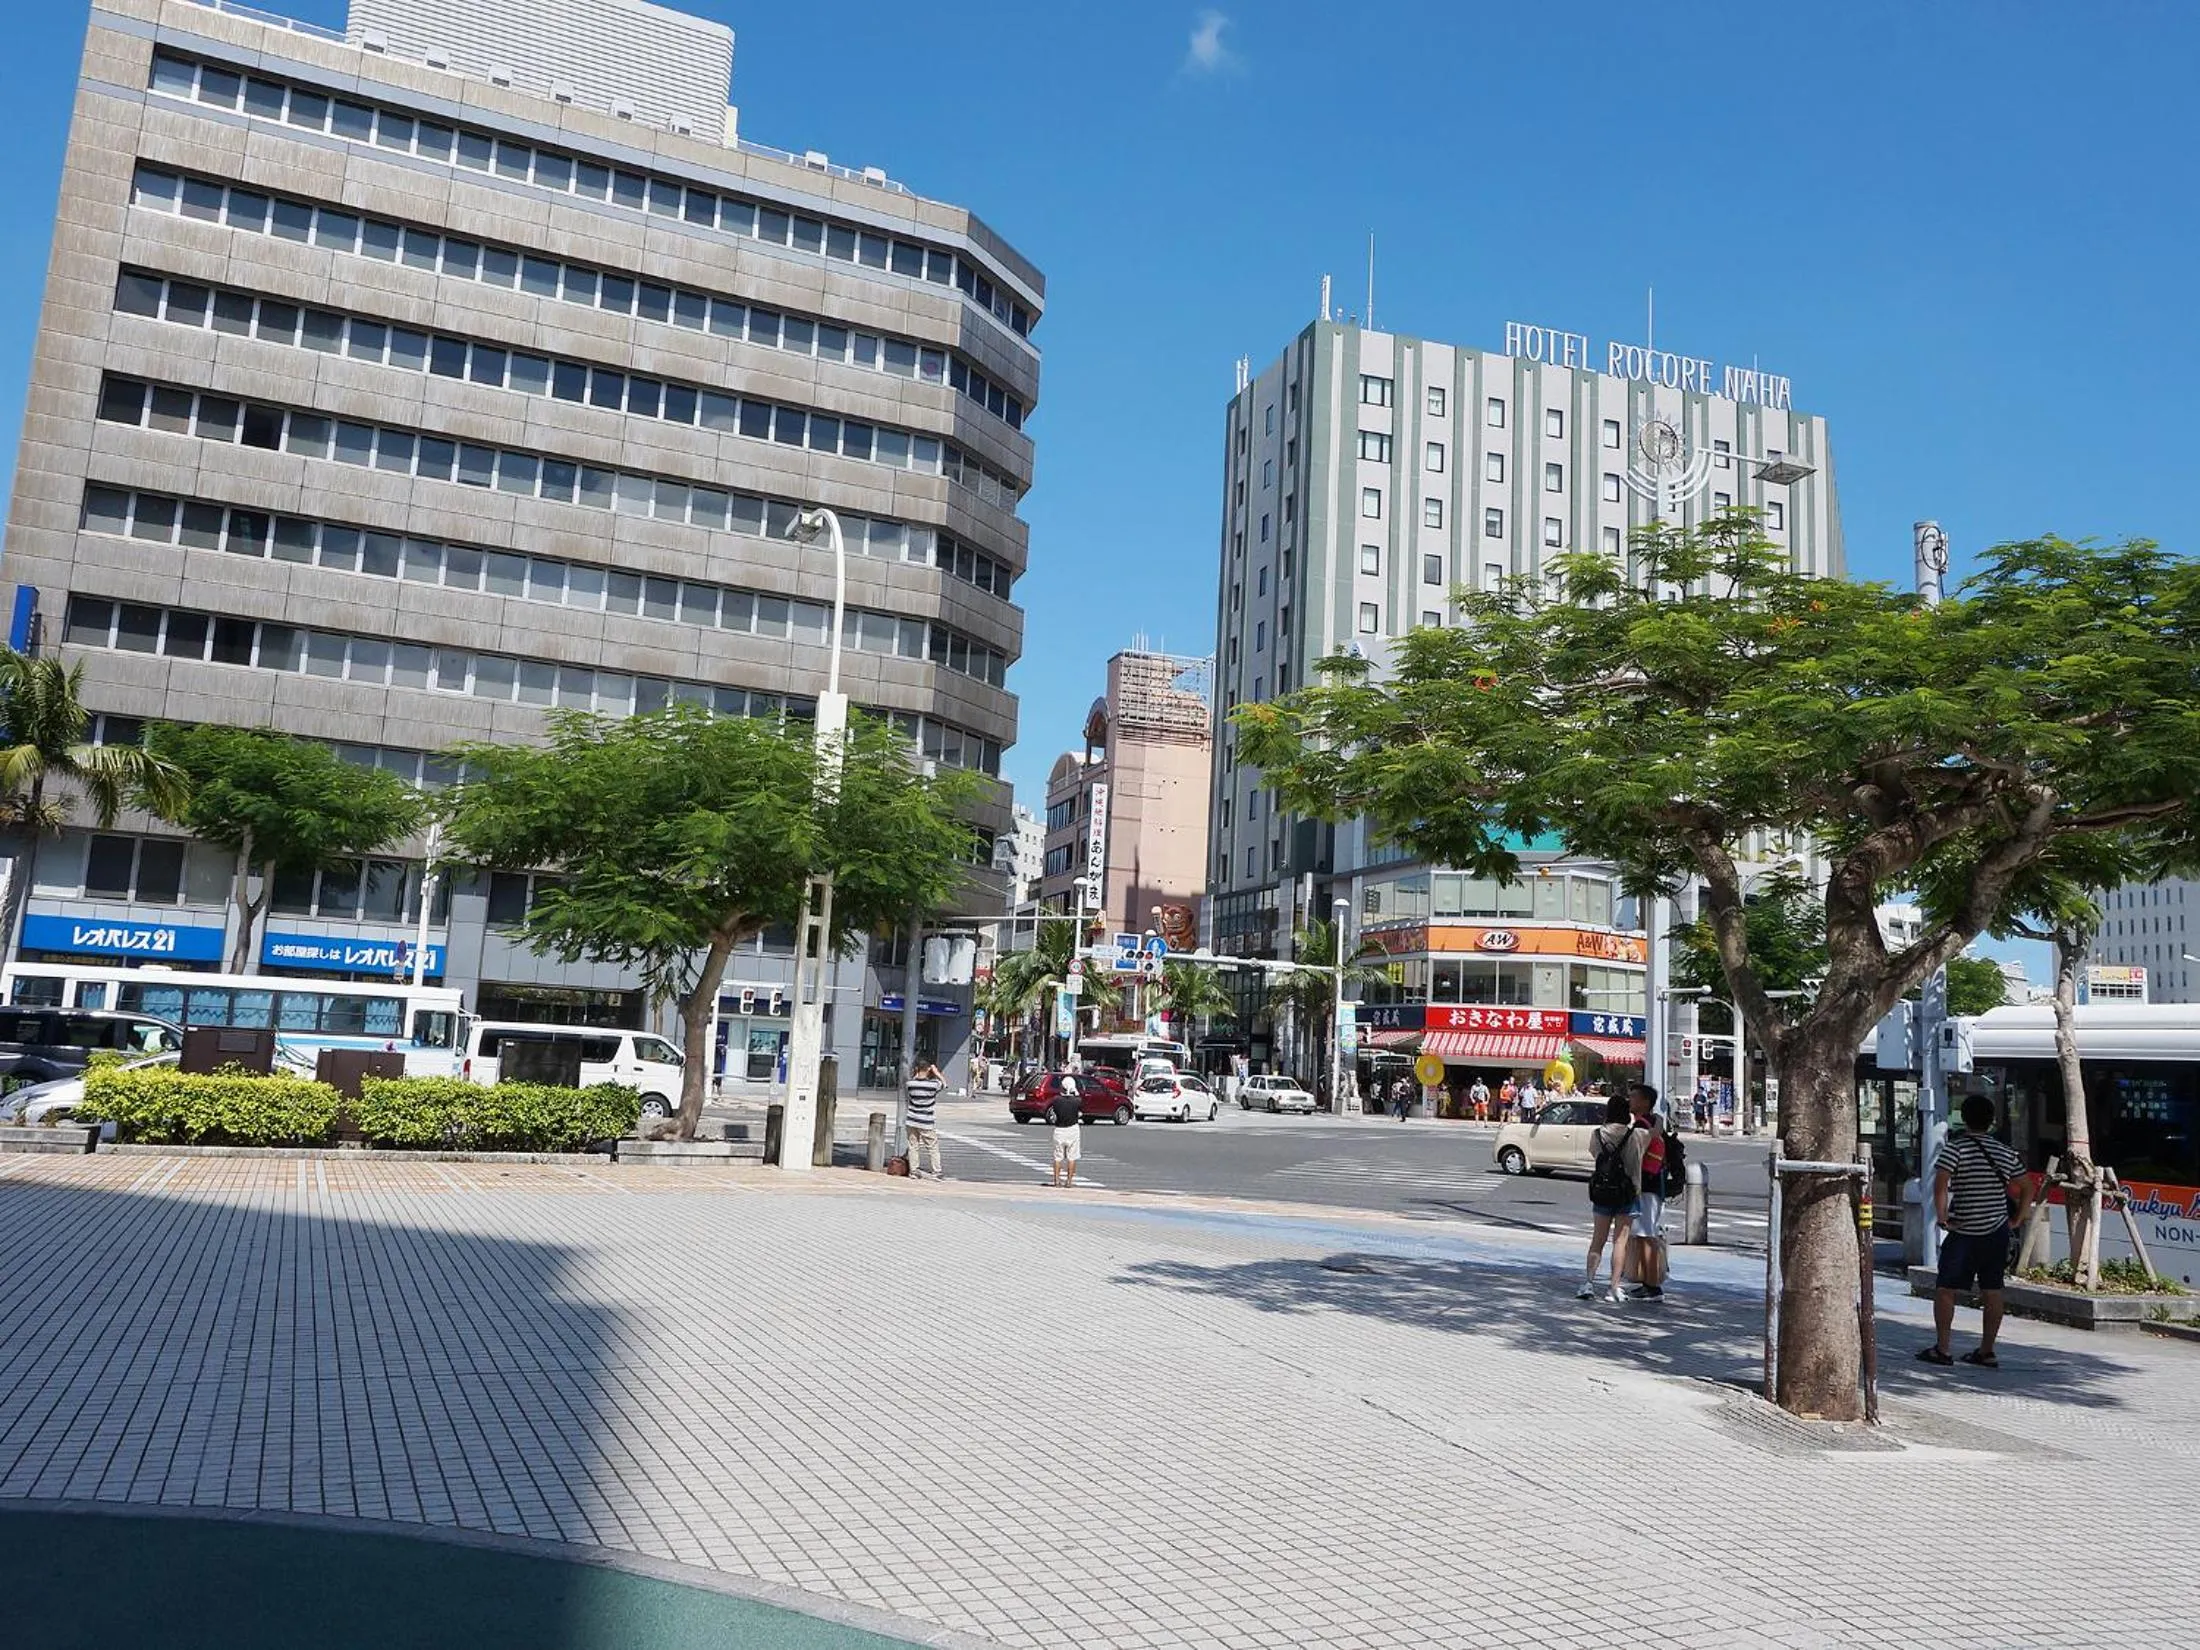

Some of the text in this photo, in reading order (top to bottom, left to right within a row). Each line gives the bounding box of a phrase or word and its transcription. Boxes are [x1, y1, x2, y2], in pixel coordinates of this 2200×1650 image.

[1505, 320, 1792, 412] HOTEL ROCORE NAHA
[72, 926, 176, 952] レオパレス21
[1576, 933, 1603, 955] A&W
[271, 944, 341, 961] お部屋探しは
[1449, 1009, 1544, 1030] おきなわ屋
